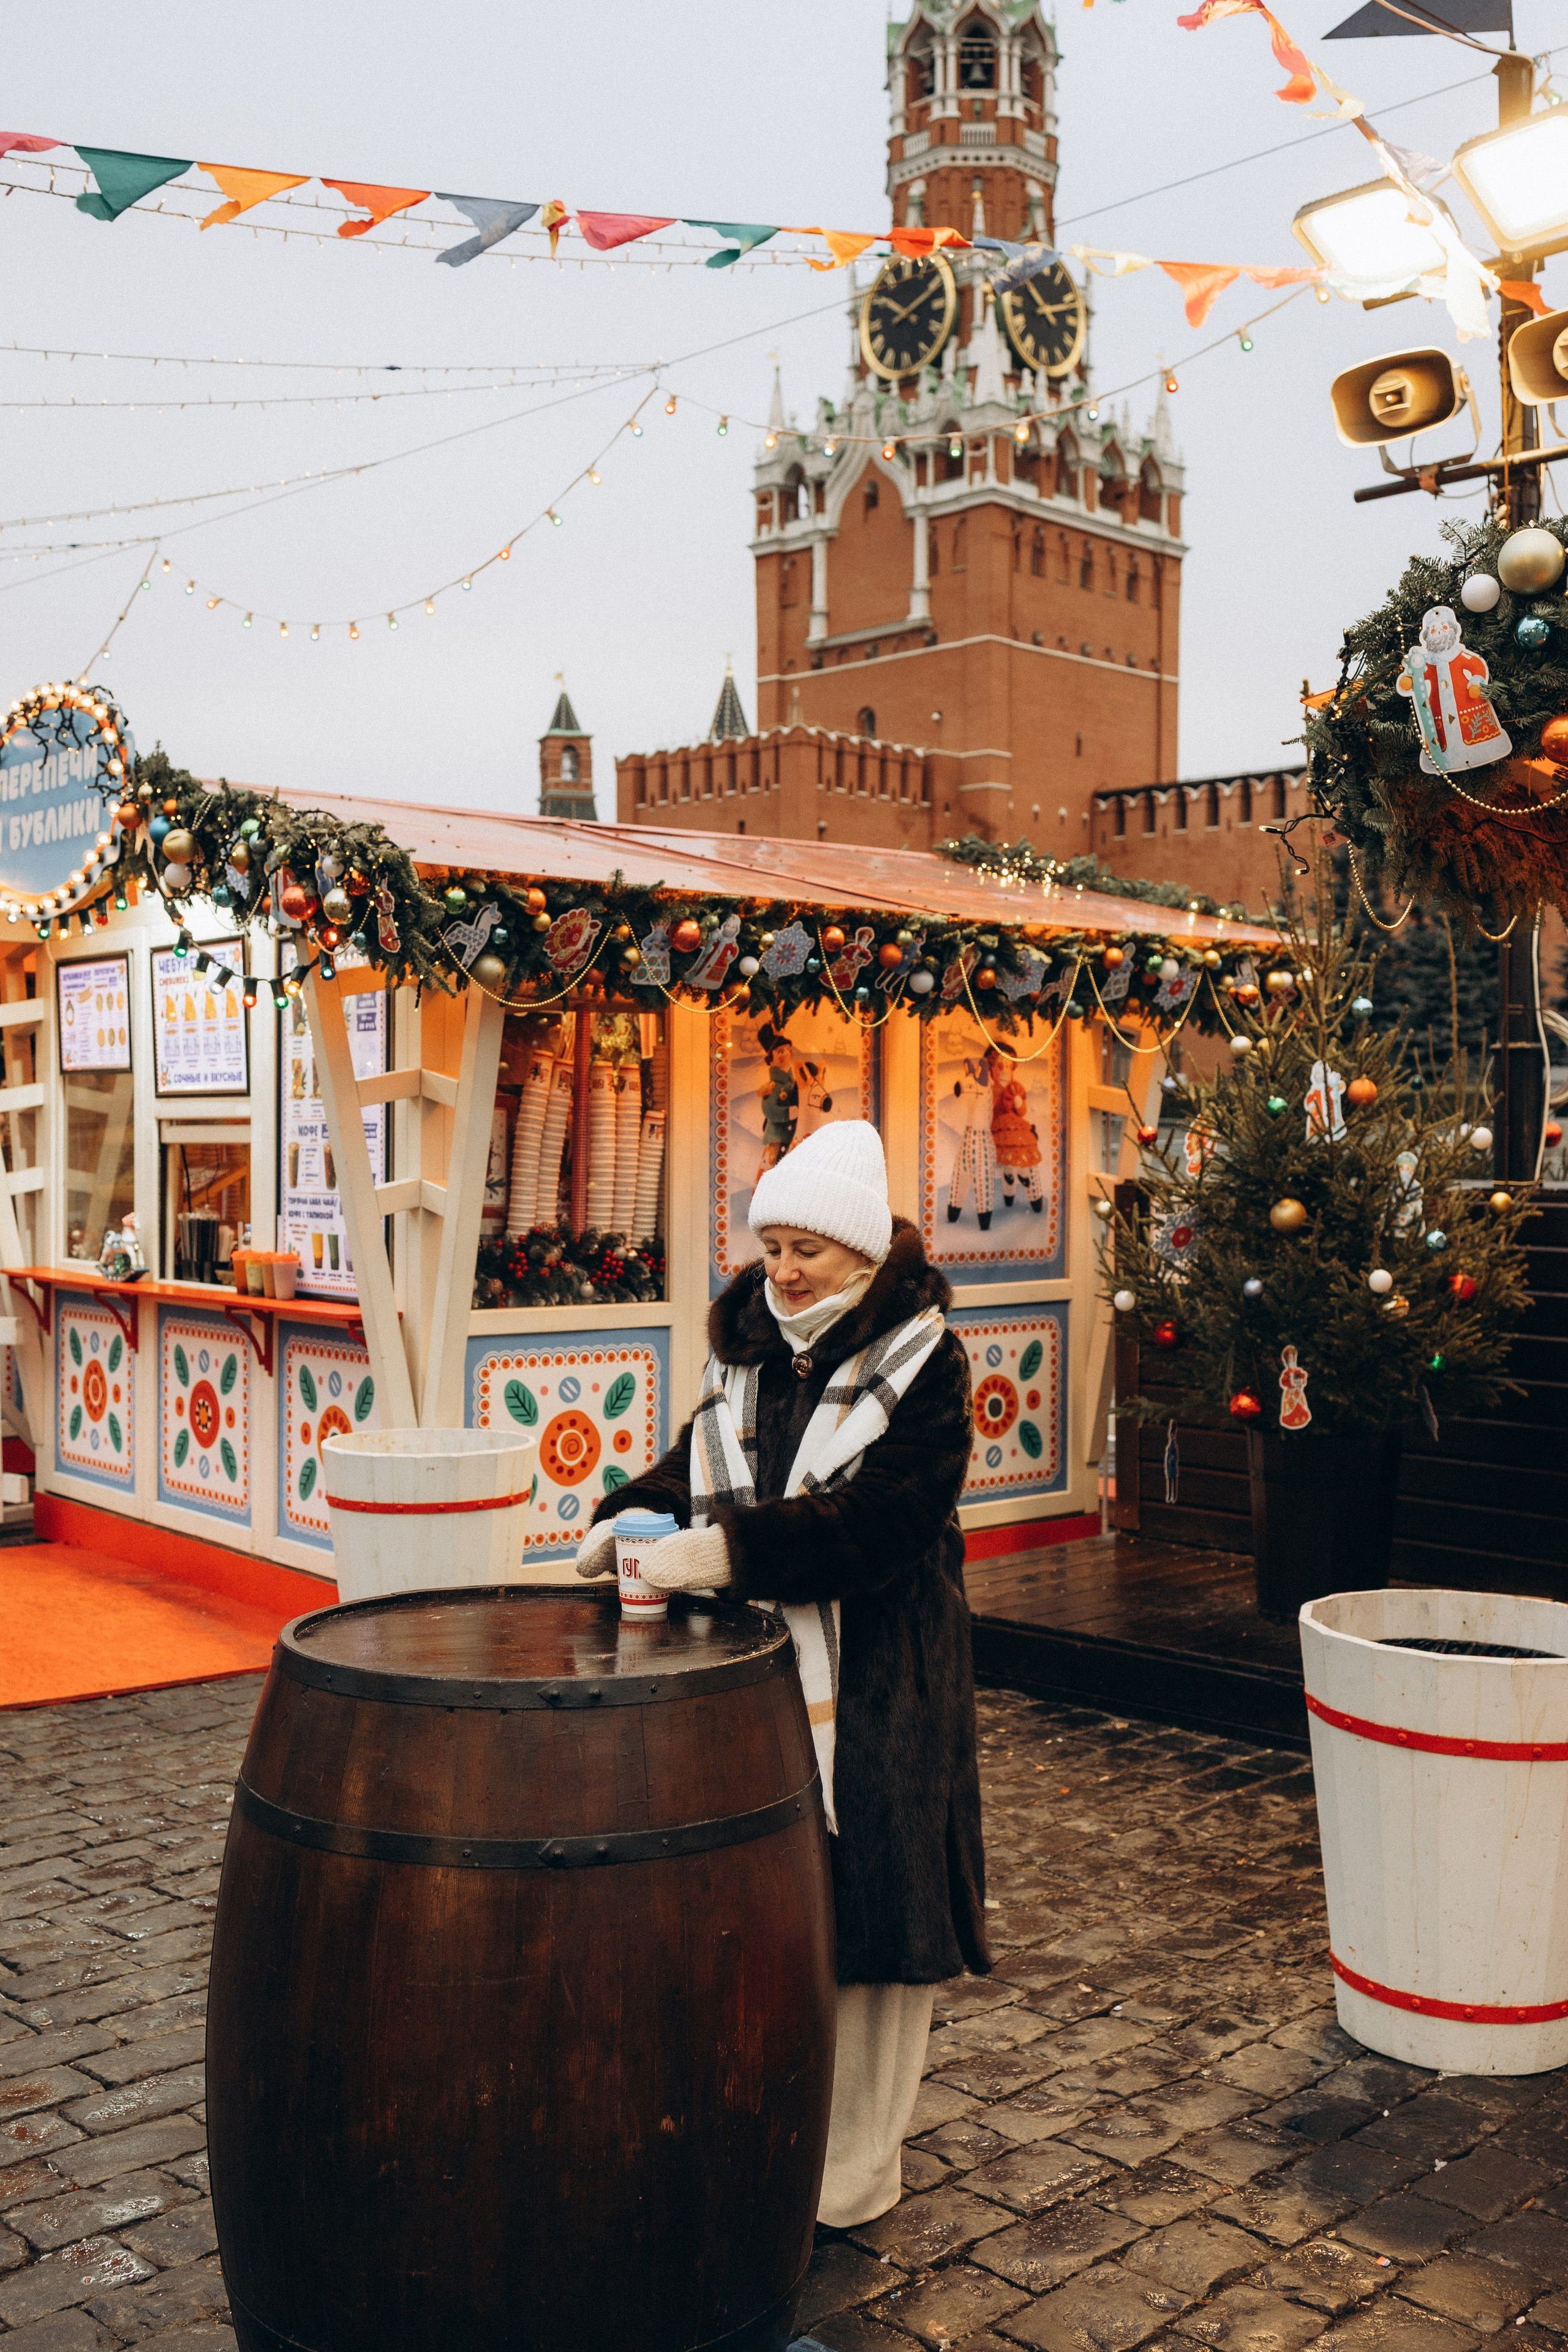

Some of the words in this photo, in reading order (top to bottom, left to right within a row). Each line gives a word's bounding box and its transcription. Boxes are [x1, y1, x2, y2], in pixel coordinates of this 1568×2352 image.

[10, 796, 100, 851] БУБЛИКИ
[159, 956, 198, 974] ЧЕБУРЕ
[298, 1125, 318, 1137] КОФЕ
